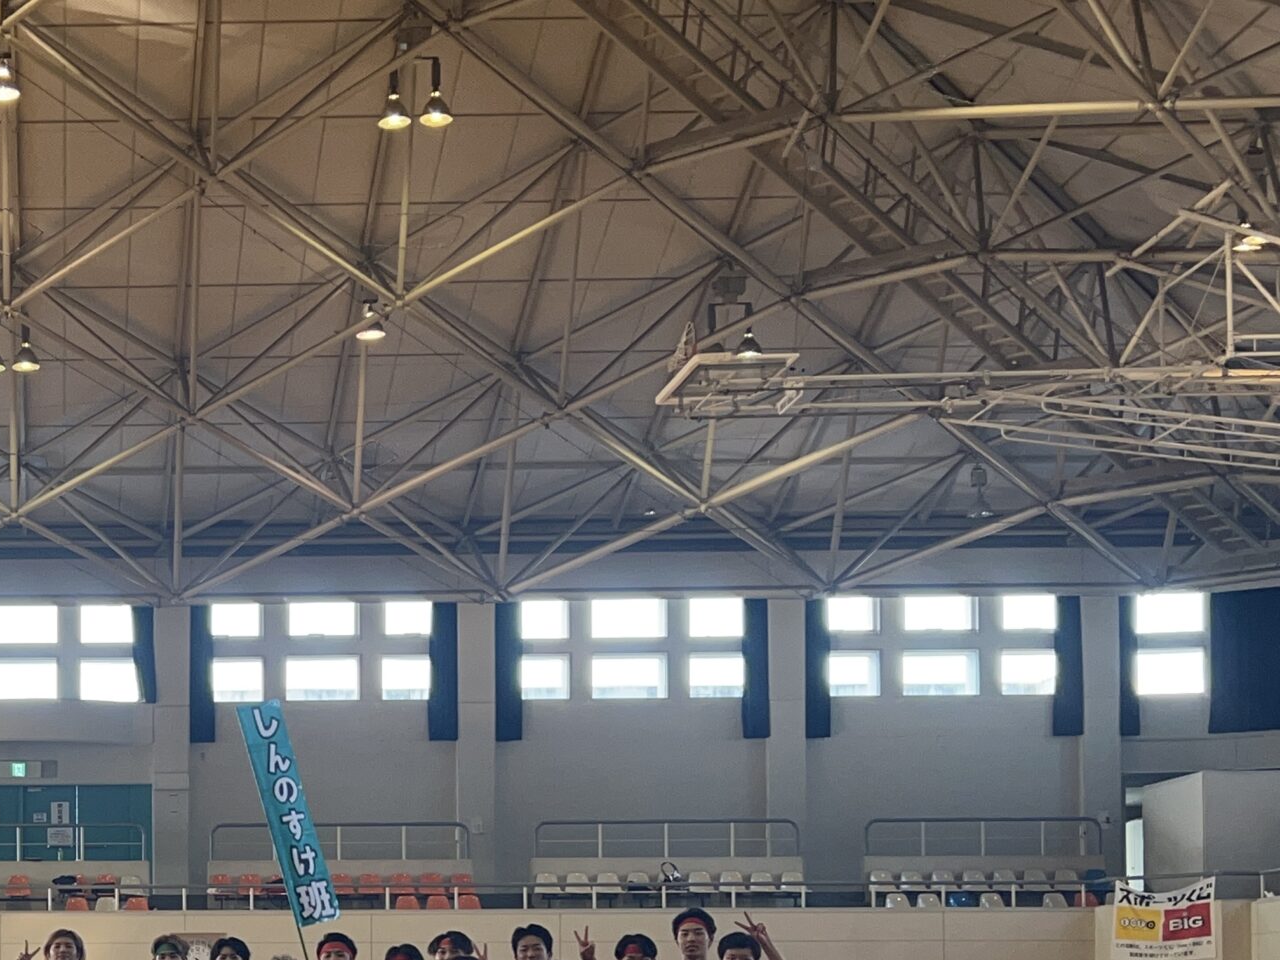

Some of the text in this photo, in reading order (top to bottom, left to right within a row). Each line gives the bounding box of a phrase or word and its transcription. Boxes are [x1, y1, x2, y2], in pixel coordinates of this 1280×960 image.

[251, 706, 336, 920] しんのすけ班
[1118, 883, 1213, 908] スポーツくじ
